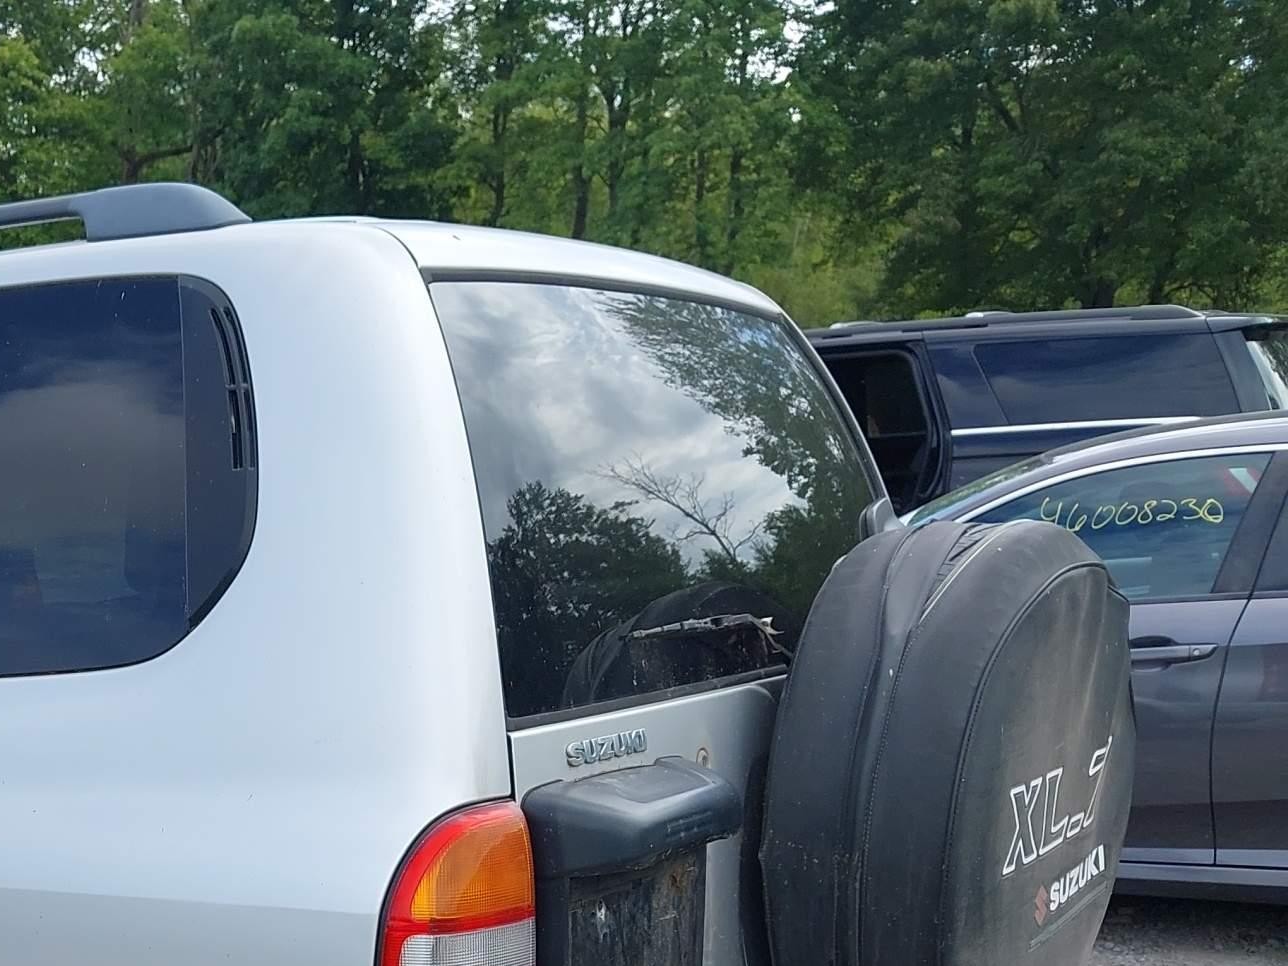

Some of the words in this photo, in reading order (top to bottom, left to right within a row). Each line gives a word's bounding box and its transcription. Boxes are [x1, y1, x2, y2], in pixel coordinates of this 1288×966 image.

[1040, 497, 1223, 531] 46008230
[566, 728, 648, 767] SUZUKI
[1049, 844, 1105, 911] SUZUKI
